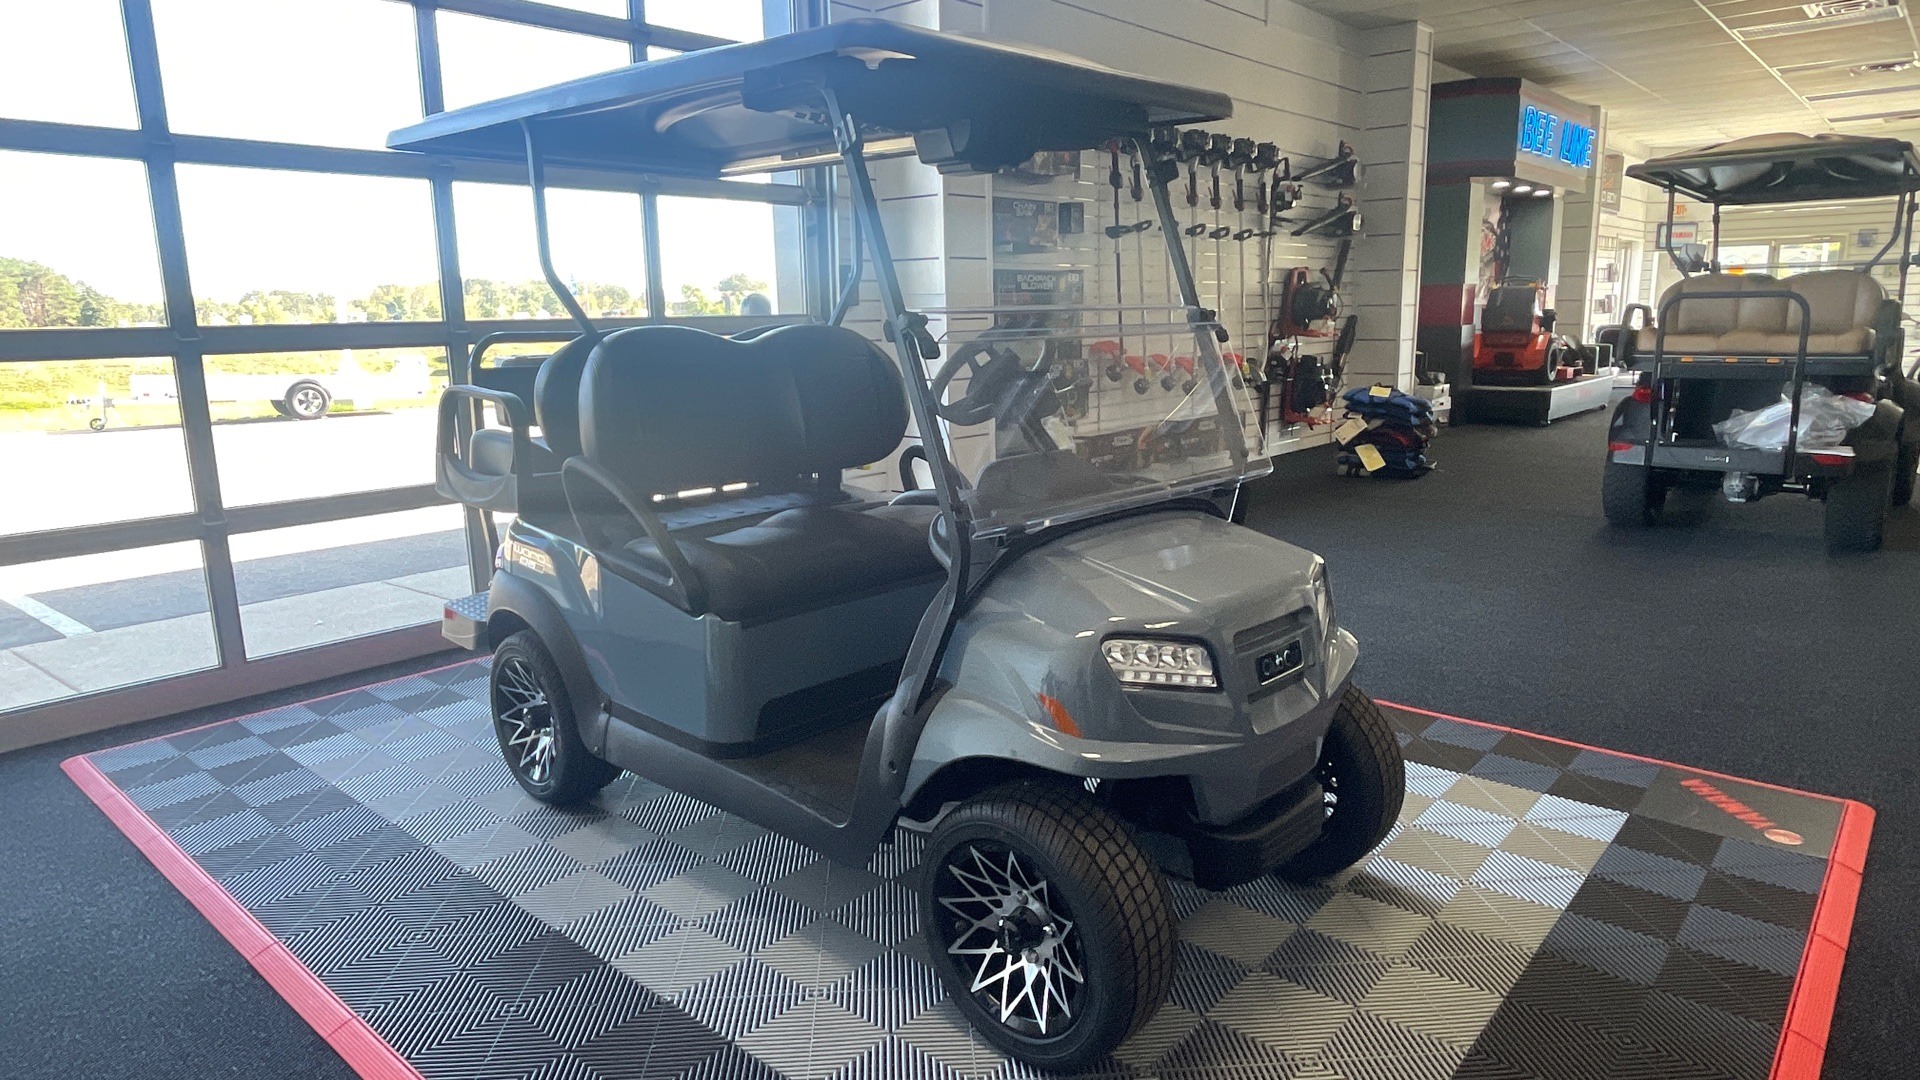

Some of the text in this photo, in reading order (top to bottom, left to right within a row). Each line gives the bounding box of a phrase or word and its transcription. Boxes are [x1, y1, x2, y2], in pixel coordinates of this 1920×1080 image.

[1521, 105, 1596, 168] BEE LINE
[1016, 274, 1057, 282] BACKPACK
[1020, 282, 1054, 290] BLOWER
